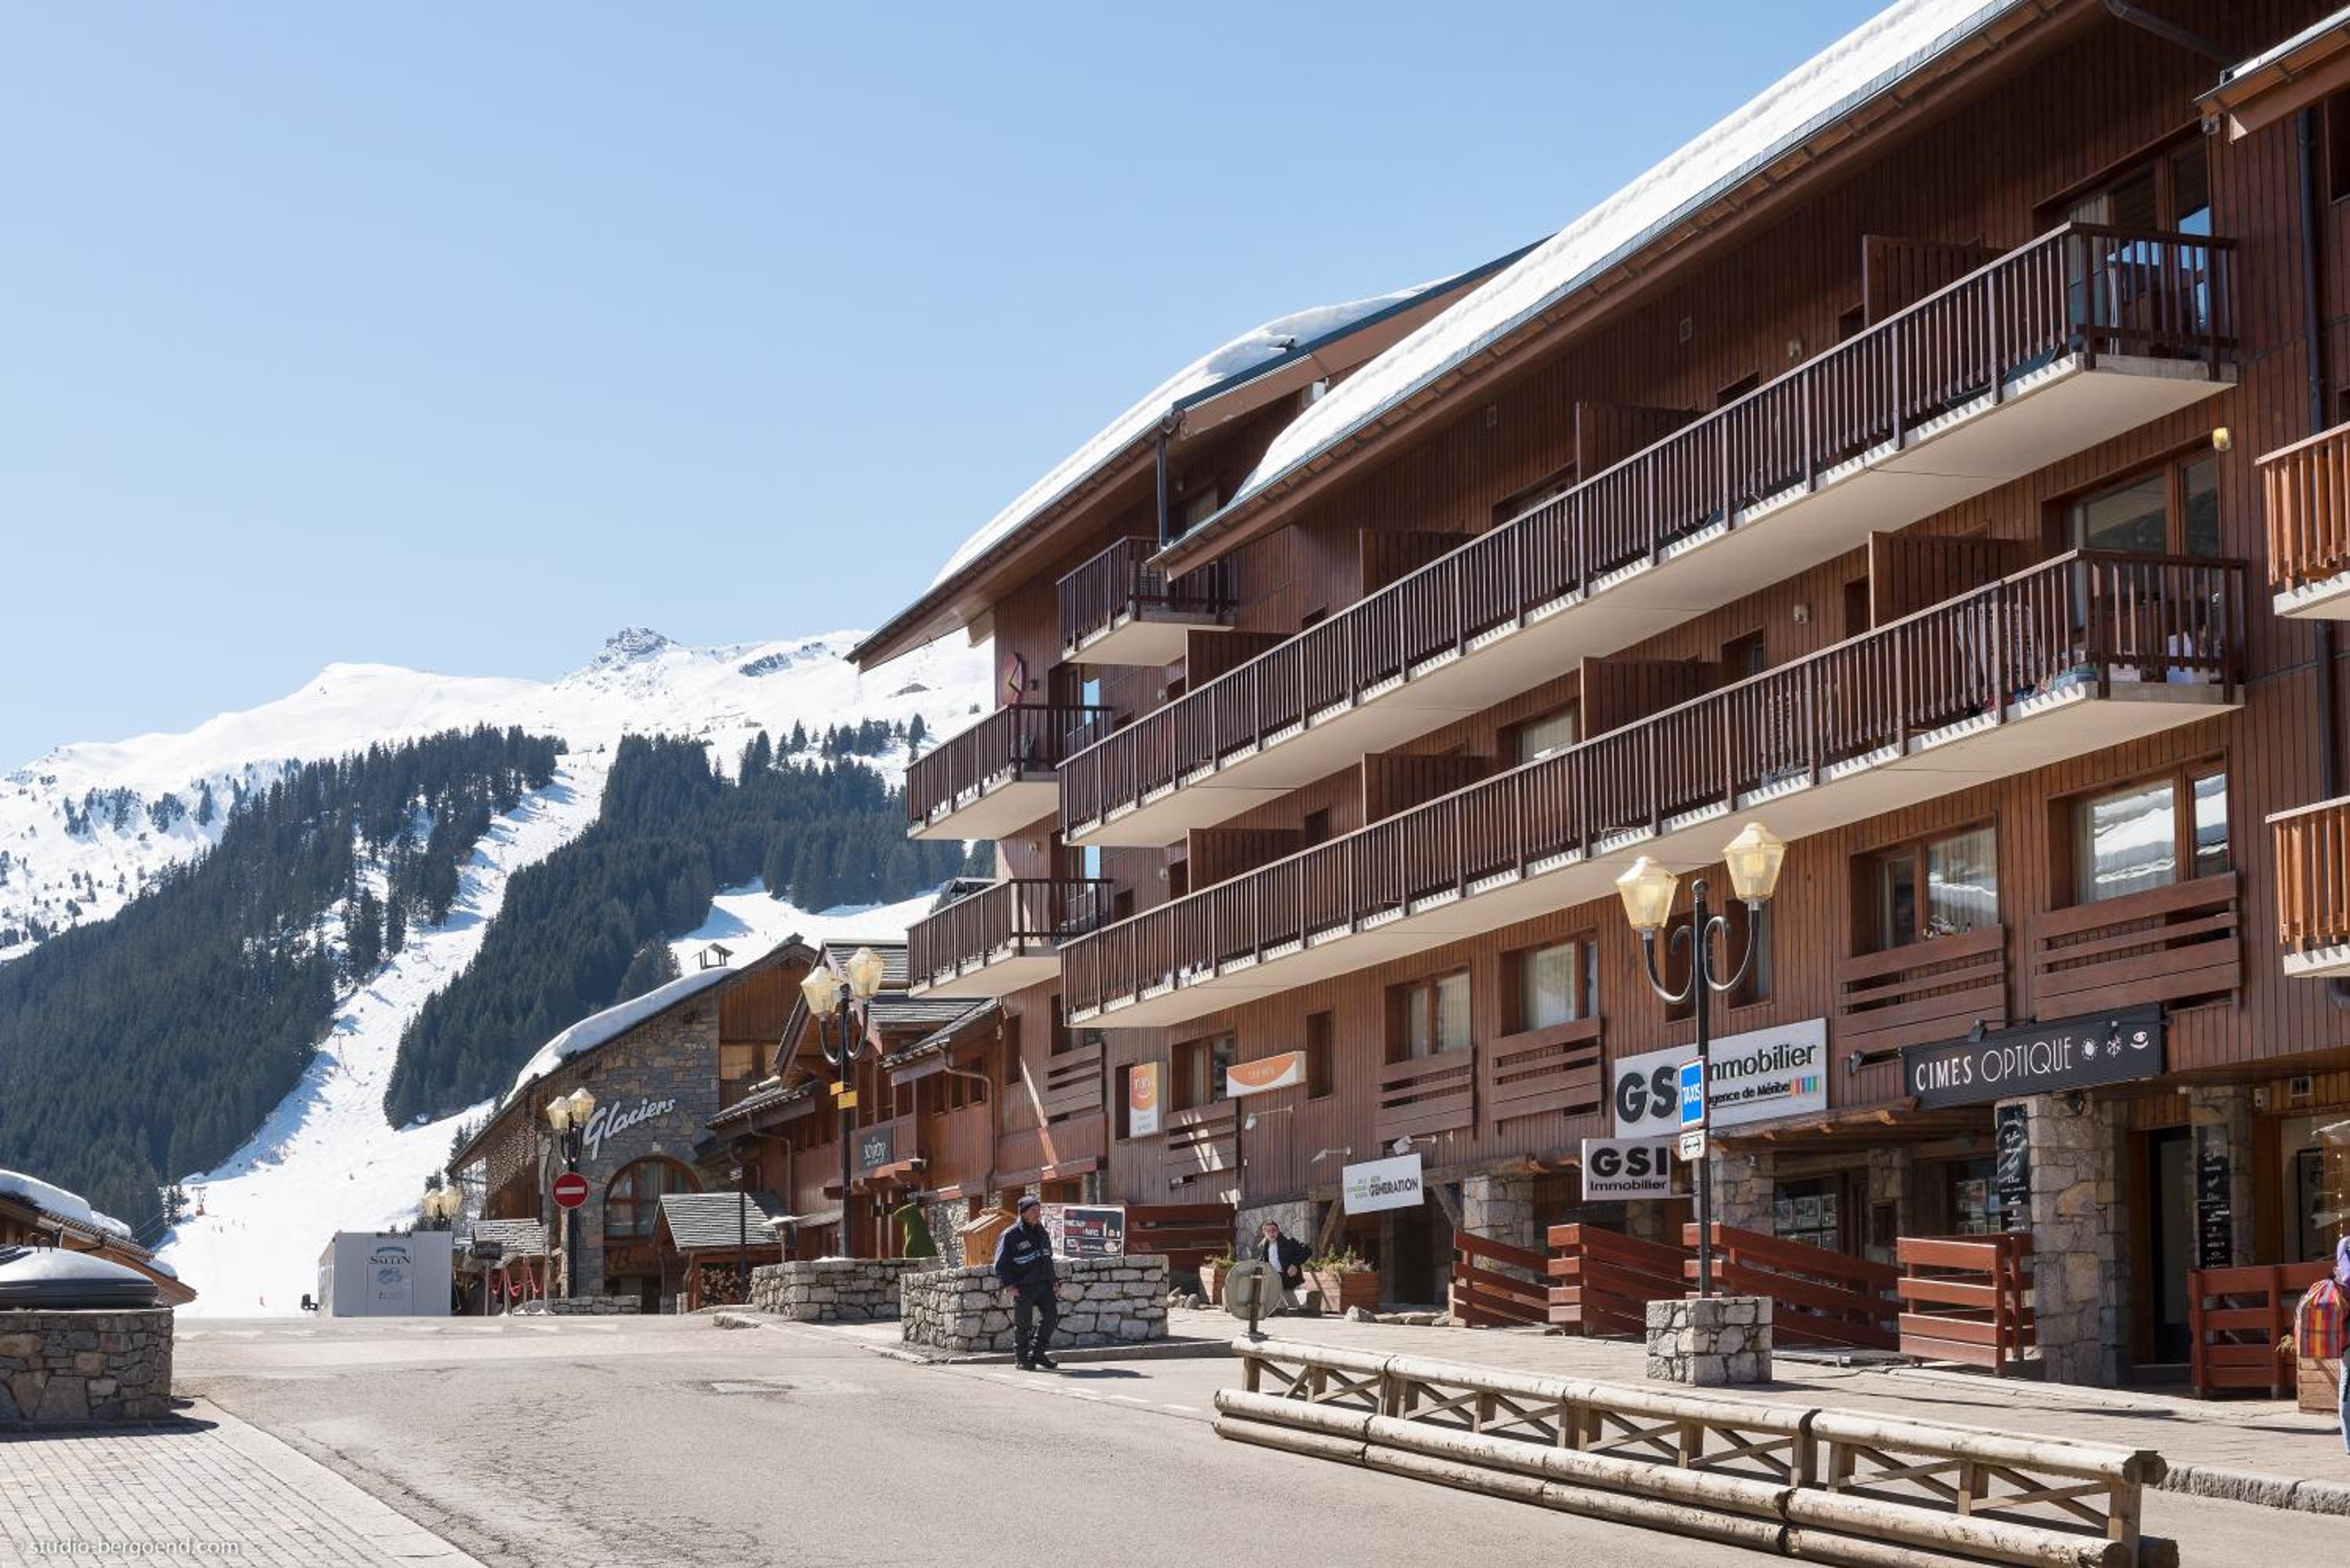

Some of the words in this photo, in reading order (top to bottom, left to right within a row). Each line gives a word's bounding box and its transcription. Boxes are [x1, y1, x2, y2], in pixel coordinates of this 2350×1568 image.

[1708, 1044, 1817, 1082] mmobilier
[1915, 1055, 1972, 1091] CIMES
[1981, 1037, 2073, 1082] OPTIQUE
[1616, 1066, 1678, 1124] GS
[1682, 1082, 1701, 1105] TAXIS
[1708, 1091, 1741, 1106] gence
[1741, 1086, 1755, 1098] de
[582, 1098, 676, 1161] Glaciers
[1589, 1146, 1668, 1177] GSI
[1369, 1177, 1419, 1197] GENERATION
[1589, 1179, 1668, 1191] Immobilier
